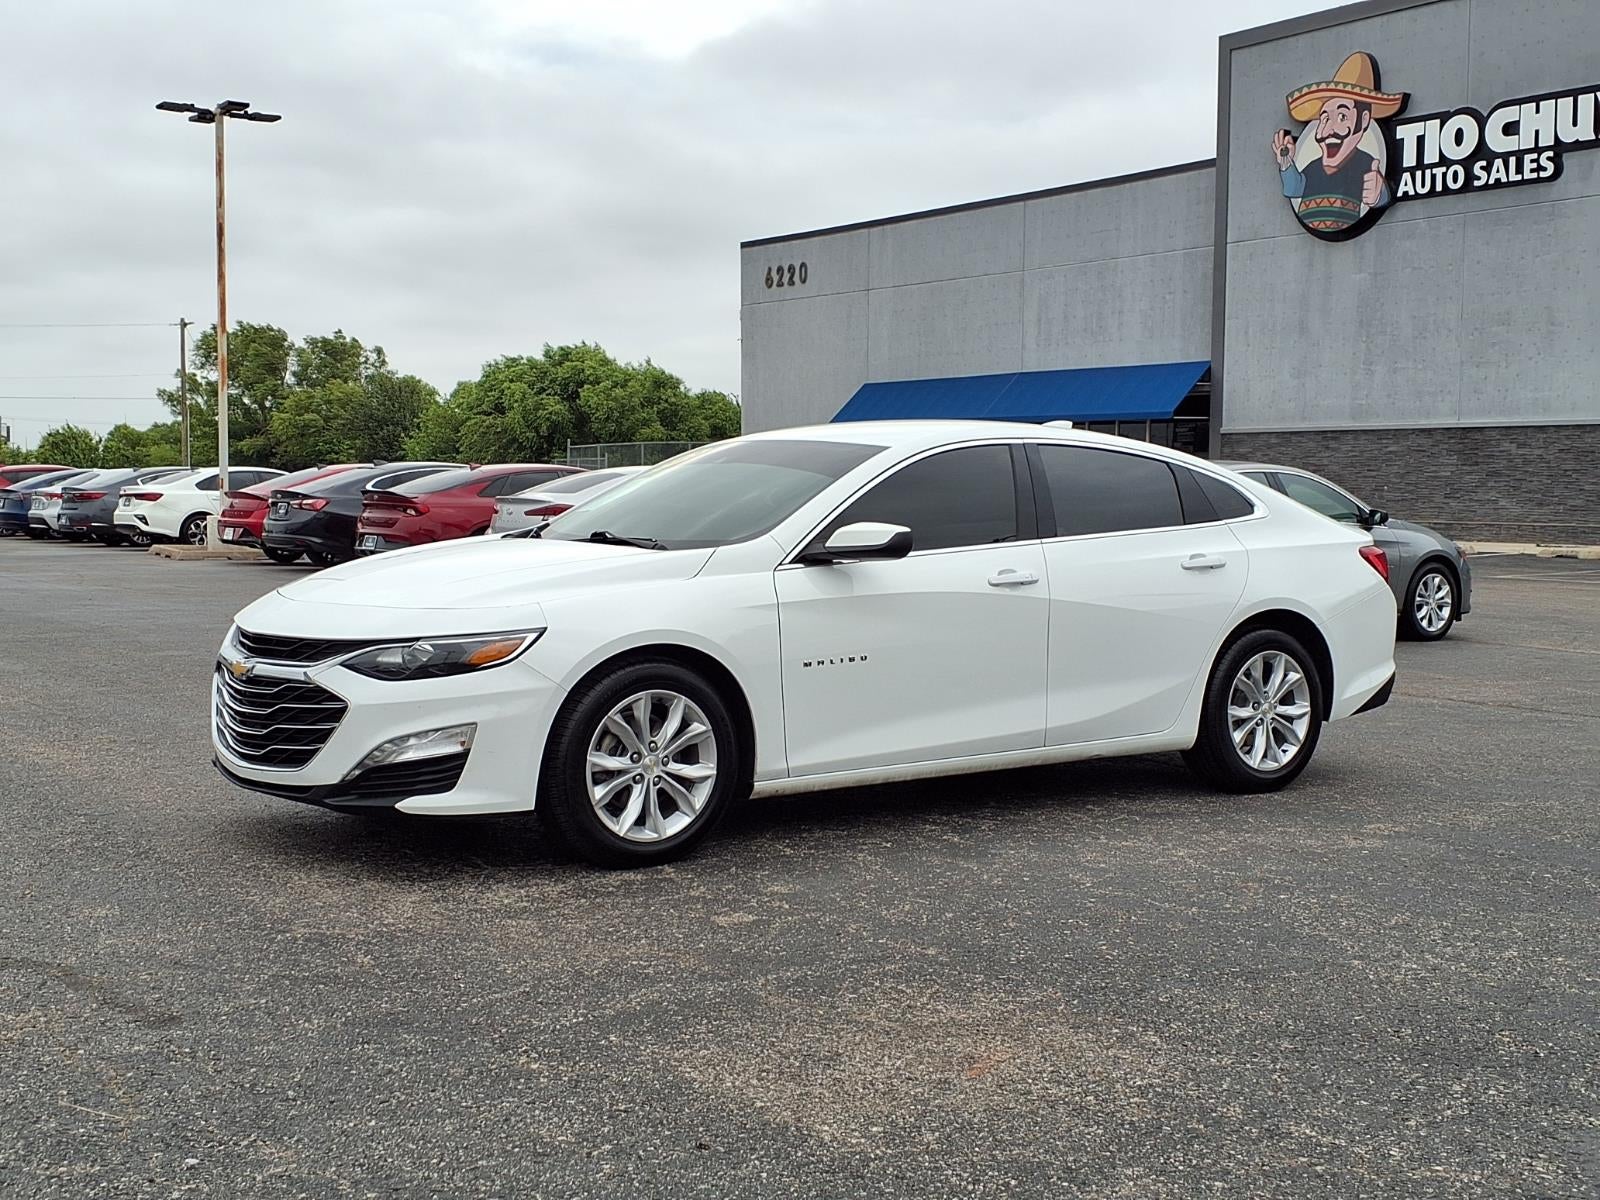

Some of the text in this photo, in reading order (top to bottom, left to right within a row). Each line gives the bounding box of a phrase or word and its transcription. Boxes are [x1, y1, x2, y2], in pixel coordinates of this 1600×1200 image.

[1396, 92, 1600, 168] TIO CHU
[1397, 151, 1555, 197] AUTO SALES
[765, 261, 808, 289] 6220
[802, 655, 868, 668] MALIBU
